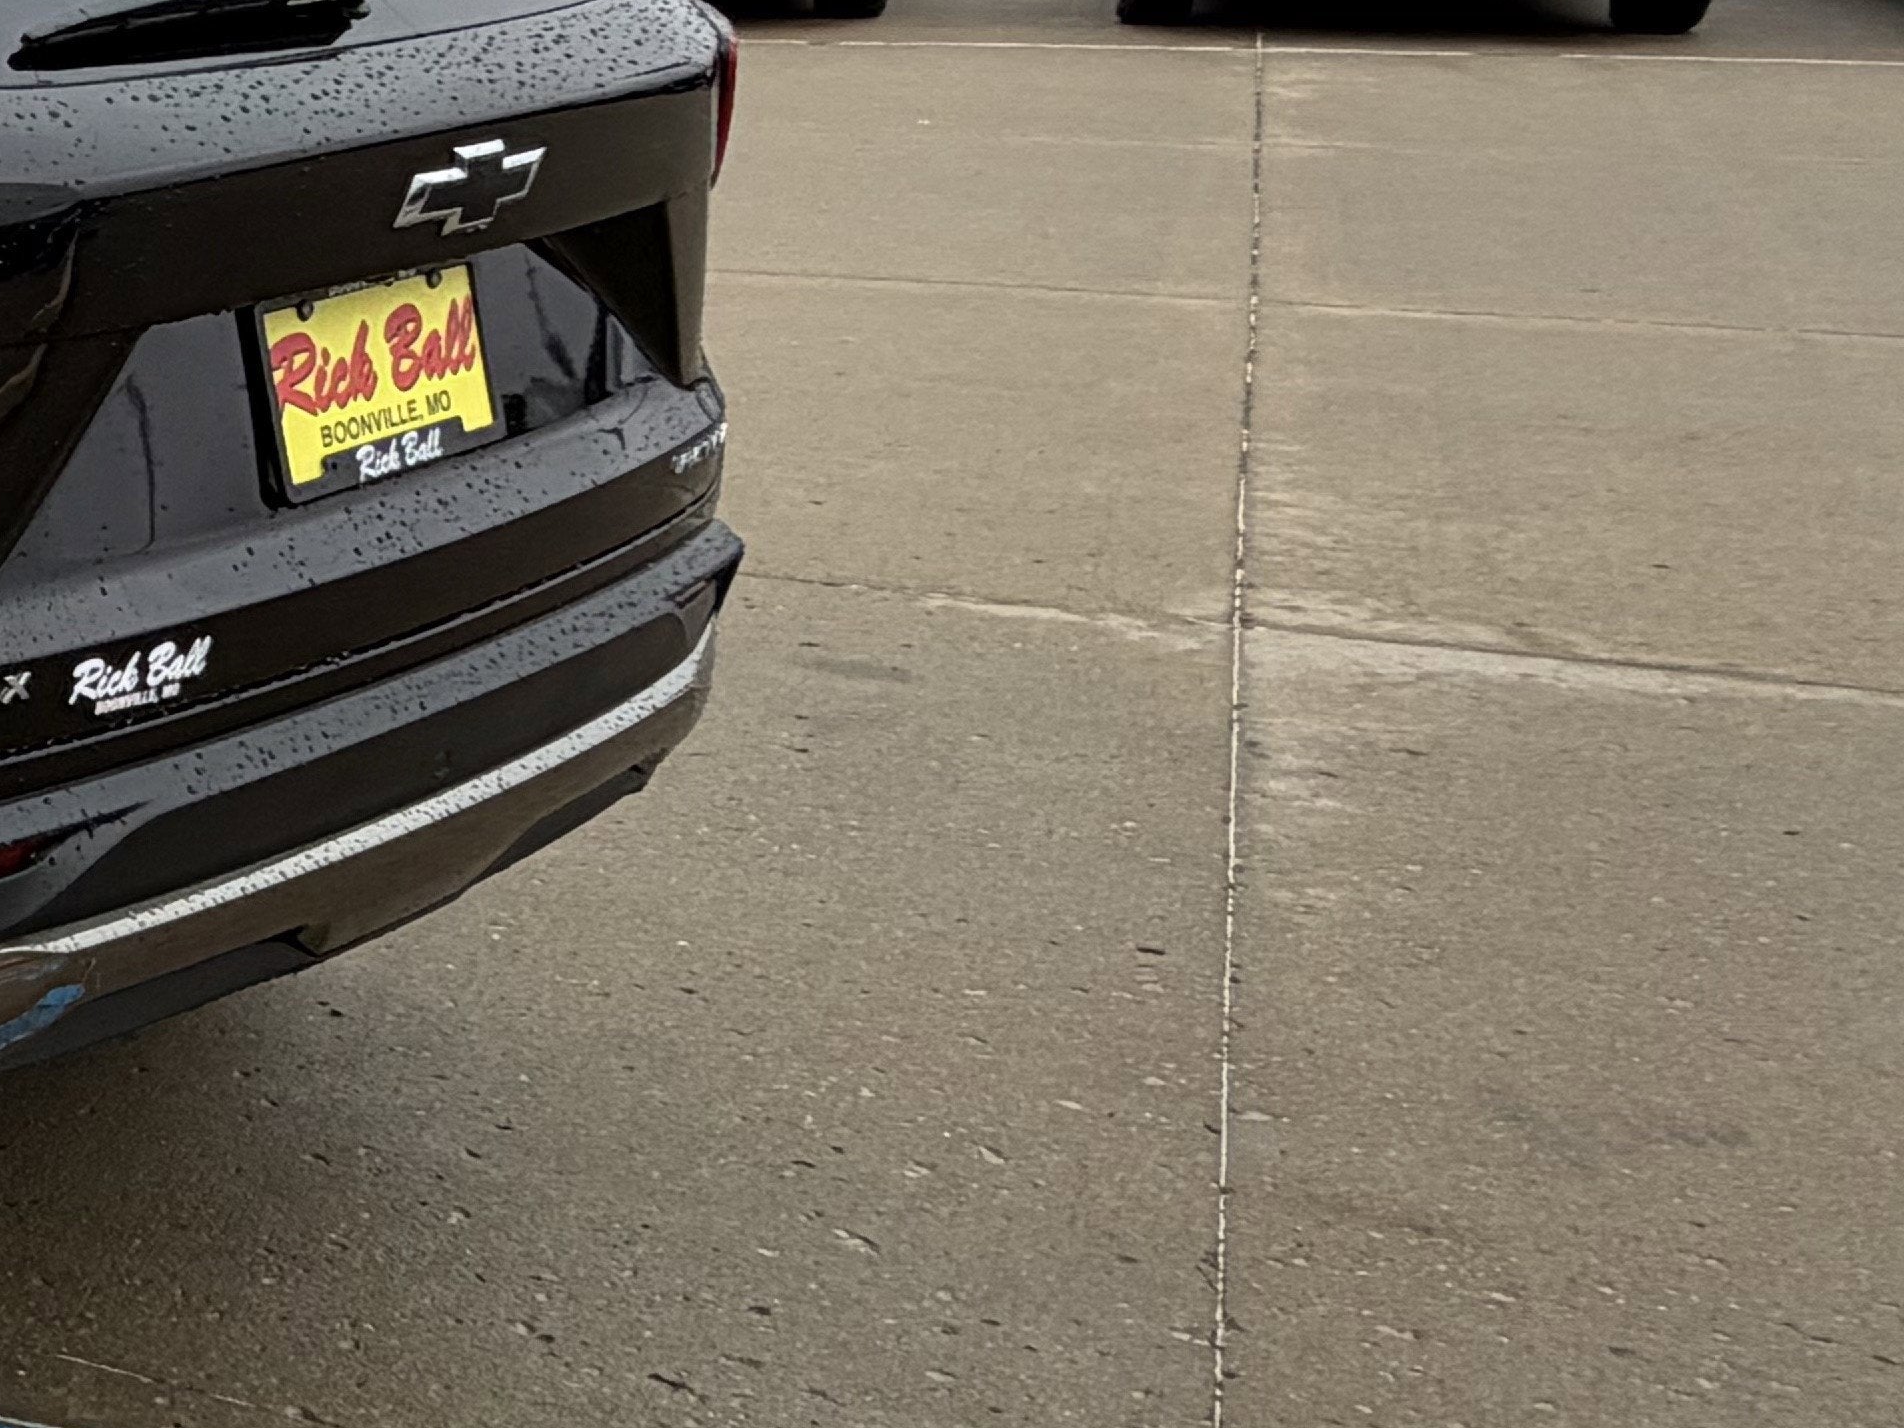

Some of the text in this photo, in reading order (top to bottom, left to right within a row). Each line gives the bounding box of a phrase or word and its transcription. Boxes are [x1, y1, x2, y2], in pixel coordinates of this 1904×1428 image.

[269, 294, 476, 416] Rick Ball
[426, 389, 452, 416] MO
[355, 426, 444, 483] Rick Ball
[68, 650, 142, 706] Rick
[146, 634, 212, 687] Ball
